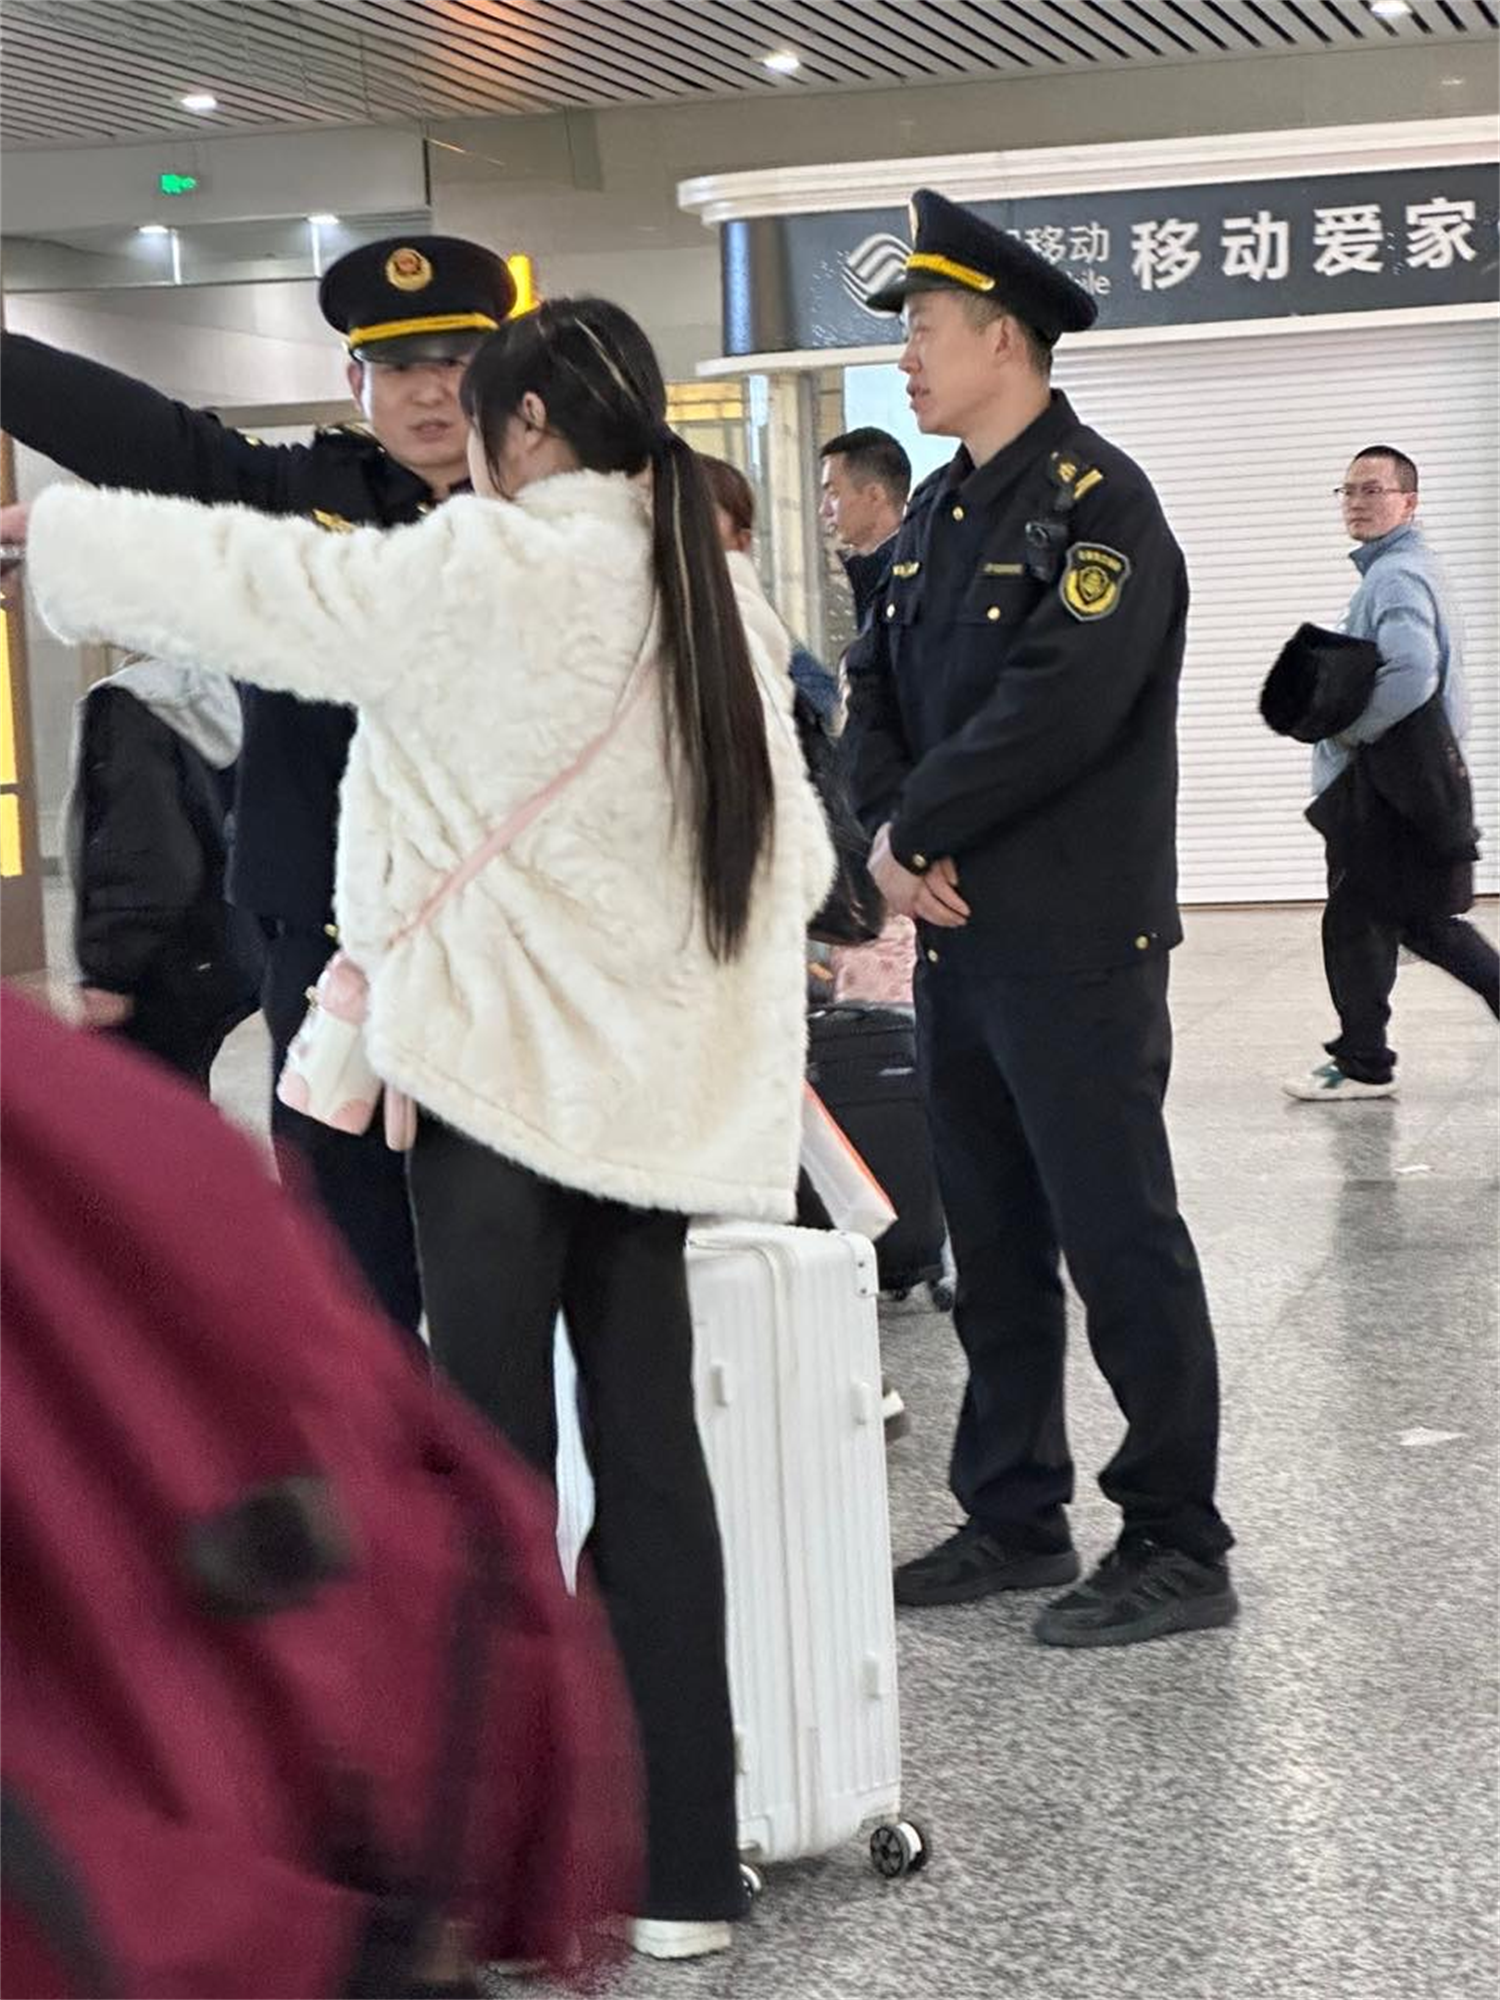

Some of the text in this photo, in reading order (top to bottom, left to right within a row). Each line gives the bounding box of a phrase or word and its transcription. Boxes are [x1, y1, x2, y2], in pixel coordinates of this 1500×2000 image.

[1006, 222, 1109, 265] 移动
[1131, 197, 1478, 291] 移动爱家
